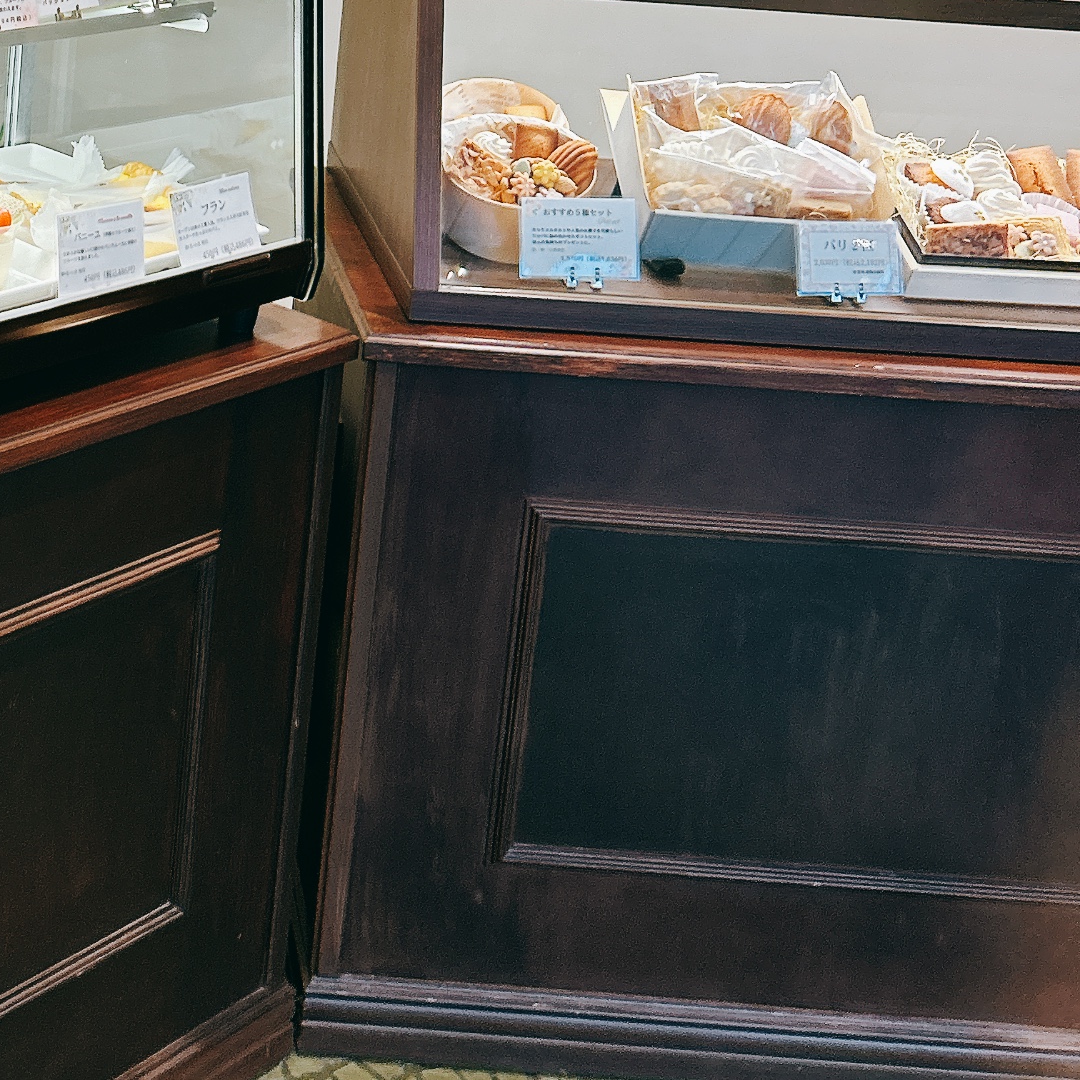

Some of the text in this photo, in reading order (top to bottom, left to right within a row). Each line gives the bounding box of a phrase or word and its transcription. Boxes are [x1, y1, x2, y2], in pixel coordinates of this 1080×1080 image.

[201, 200, 226, 215] フラン
[543, 208, 612, 216] おすすめ5種セット
[824, 240, 846, 250] パリ
